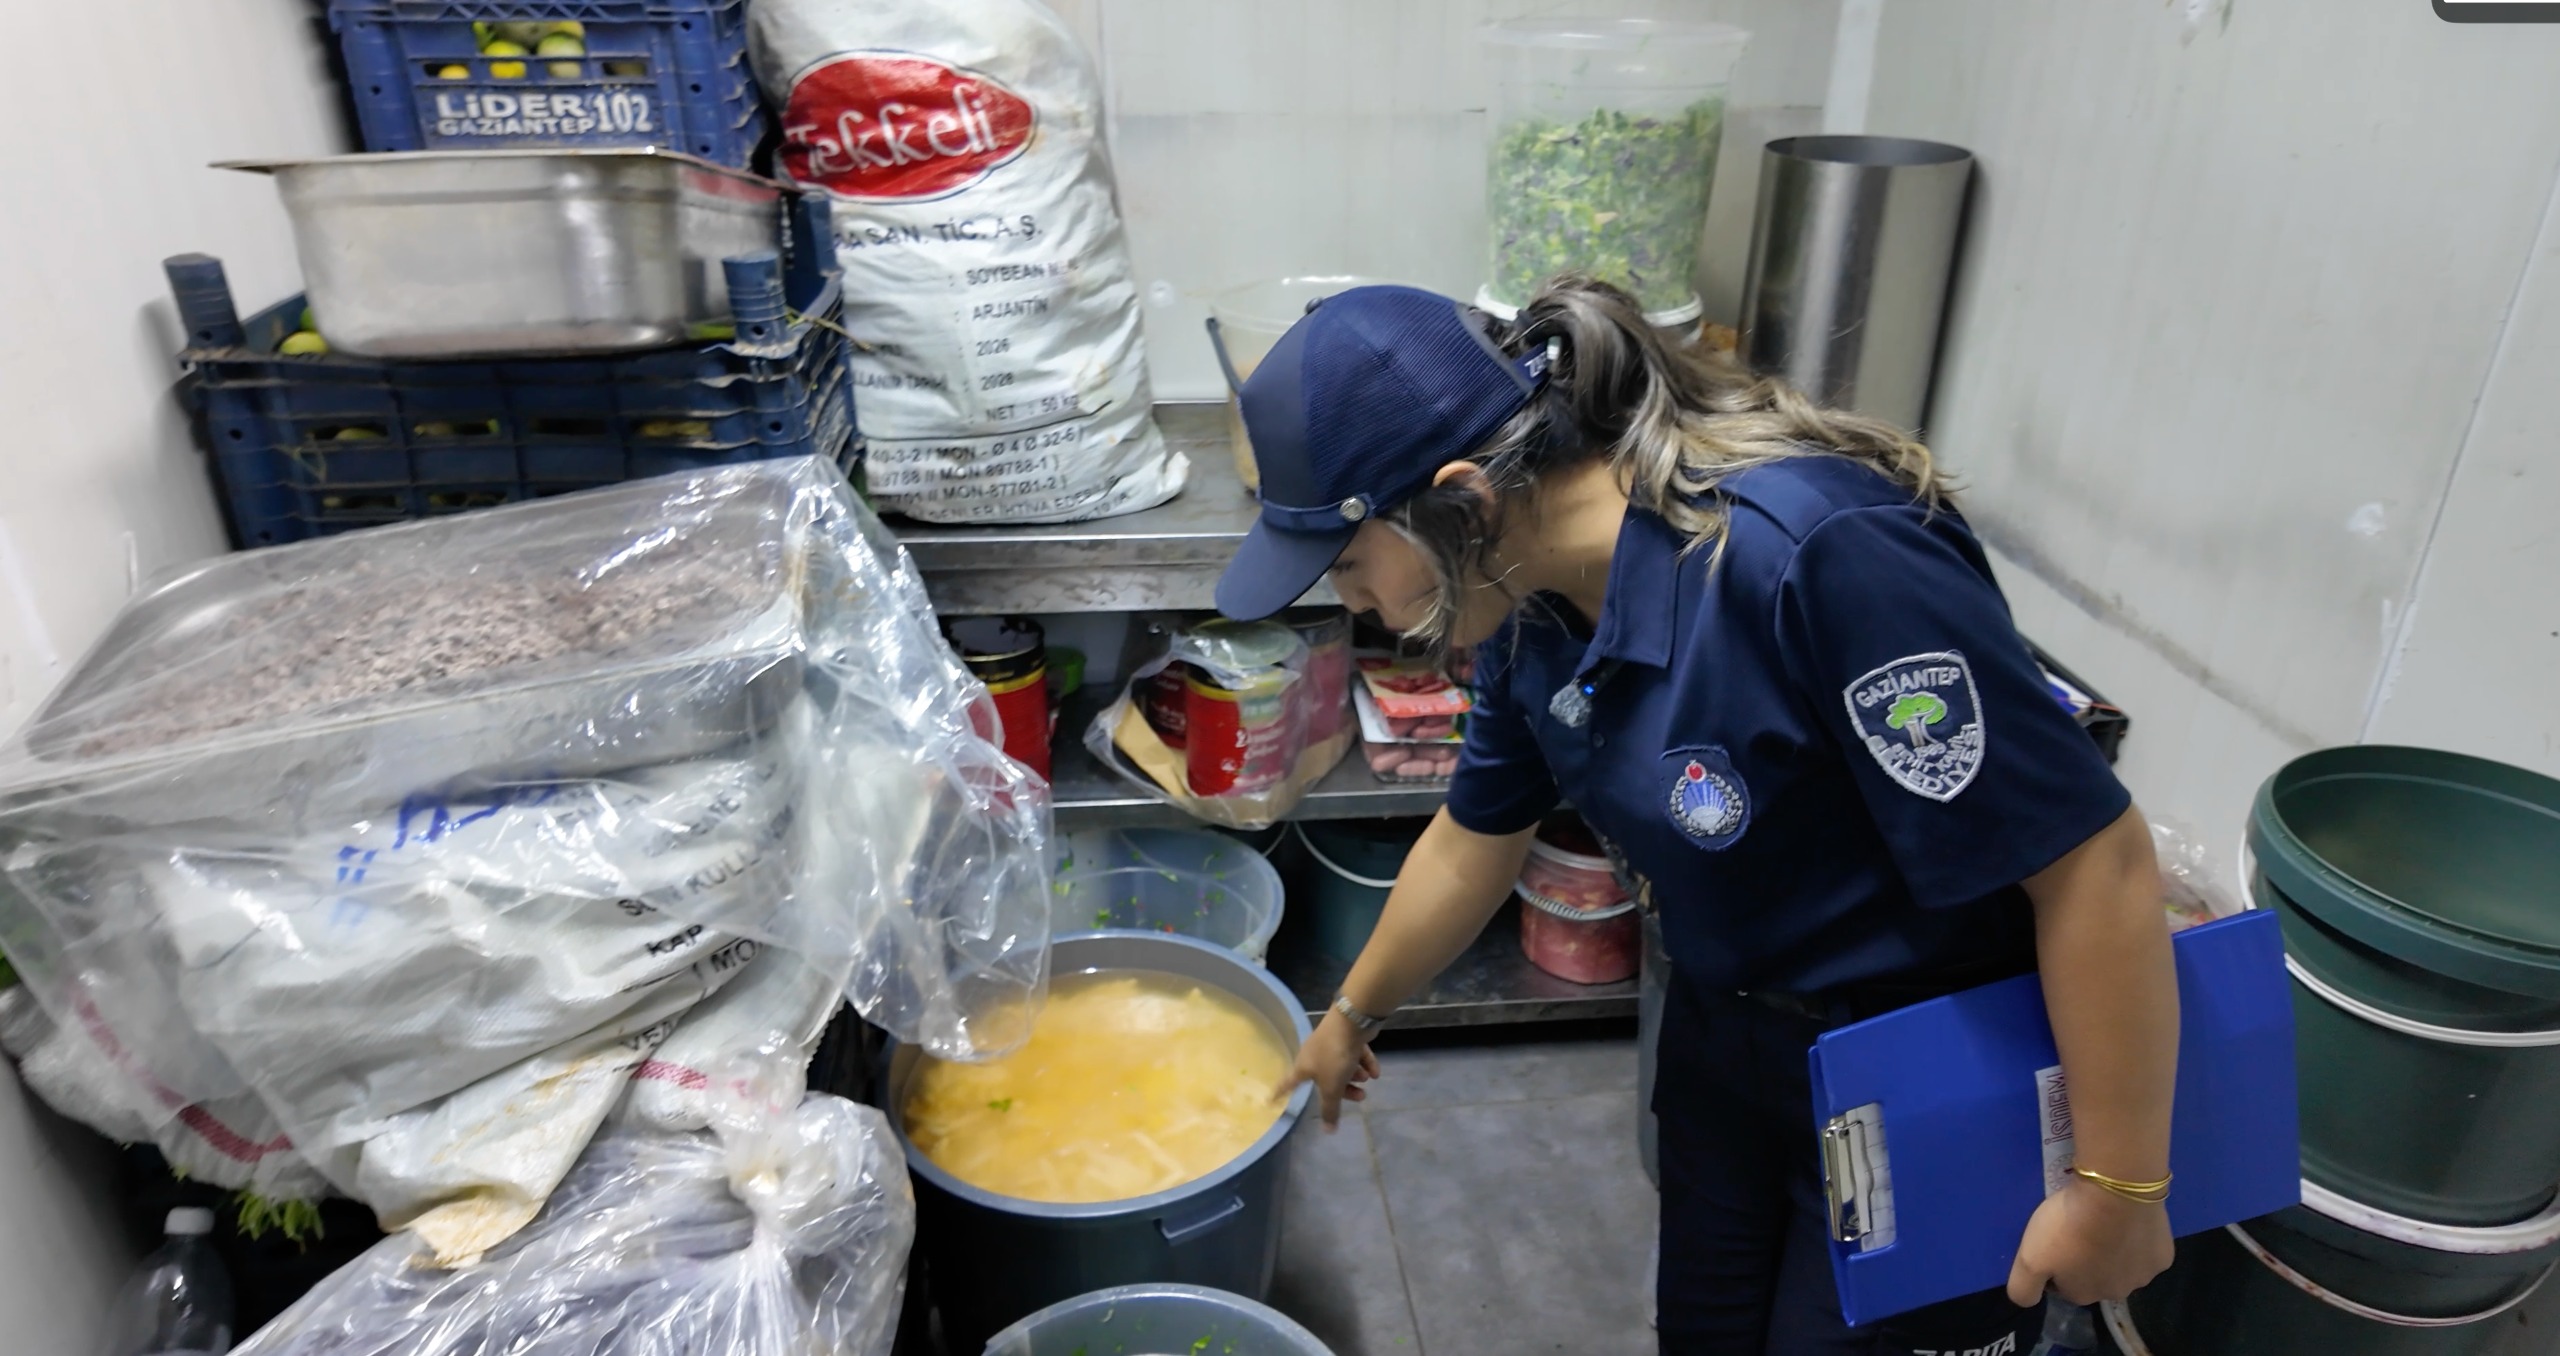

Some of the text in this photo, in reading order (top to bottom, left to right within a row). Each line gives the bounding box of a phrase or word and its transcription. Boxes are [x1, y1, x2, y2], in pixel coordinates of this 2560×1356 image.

[593, 92, 654, 133] 102
[784, 83, 999, 177] Tekkeli
[966, 264, 1046, 286] SOYBEAN
[985, 404, 1016, 422] NET
[1855, 667, 1961, 708] GAZİANTEP
[710, 938, 763, 974] MO
